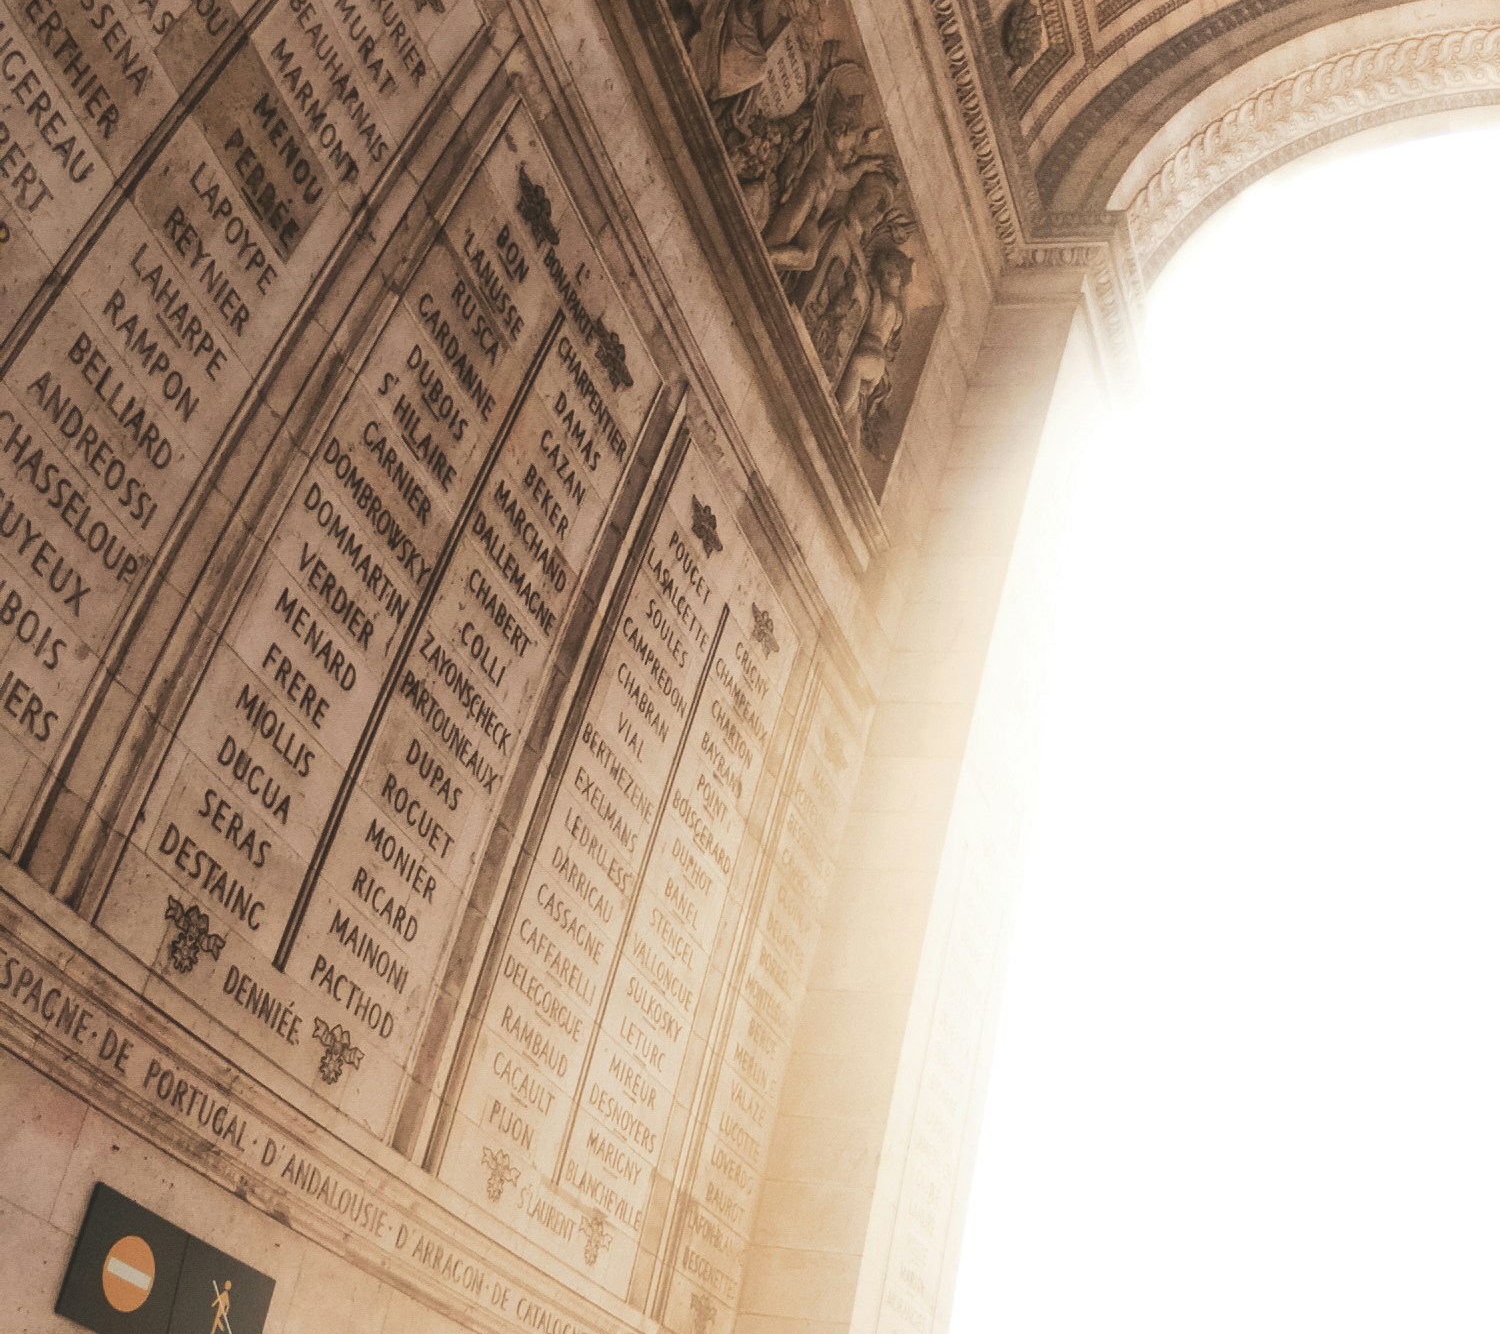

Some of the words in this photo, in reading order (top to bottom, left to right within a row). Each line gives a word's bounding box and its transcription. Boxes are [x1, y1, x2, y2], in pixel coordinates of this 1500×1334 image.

[253, 92, 323, 204] MENOU
[270, 37, 359, 183] MARMONT
[165, 204, 251, 337] REYNIER
[189, 161, 278, 296] LAPOYPE
[496, 224, 530, 284] BON
[130, 243, 228, 381] LAHARPE
[464, 232, 525, 342] LANUSSE
[543, 247, 596, 346] BONAPARTE
[68, 331, 172, 469] BELLIARD
[102, 288, 200, 423] RAMPON
[406, 343, 469, 441] DUBOIS
[557, 336, 628, 462] CHARPENTIER
[27, 370, 157, 530] ANDREOSSI
[392, 393, 457, 493] HILAIRE
[554, 390, 601, 472] DAMAS
[323, 437, 431, 586] DOMBROWSKY
[493, 479, 568, 593] MARCHAND
[523, 463, 569, 540] BEKER
[299, 542, 374, 651] VERDIER
[303, 481, 411, 625] DOMMARTIN
[274, 587, 357, 691] MENARD
[460, 621, 507, 688] COLLI
[468, 568, 532, 659] CHABERT
[262, 642, 330, 730] FRERE
[617, 662, 670, 743] CHABRAN
[622, 617, 689, 719] CAMPREDON
[234, 683, 316, 778] MIOLLIS
[400, 669, 500, 796] PARTOUNEAUX
[405, 738, 463, 811] DUPAS
[617, 711, 645, 763] VIAL
[198, 788, 272, 869] SERAS
[365, 818, 437, 905] MONIER
[352, 866, 418, 942] RICARD
[551, 845, 614, 924] DARRICAU
[664, 877, 699, 931] BANEL
[310, 954, 394, 1039] PACTHOD
[329, 909, 408, 994] MAINONI
[519, 917, 597, 1007] CAFFARELLI
[97, 1027, 134, 1073] DE
[142, 1058, 248, 1152] PORTUGAL
[501, 1005, 568, 1079] RAMBAUD
[588, 1082, 657, 1154] DESNOYERS
